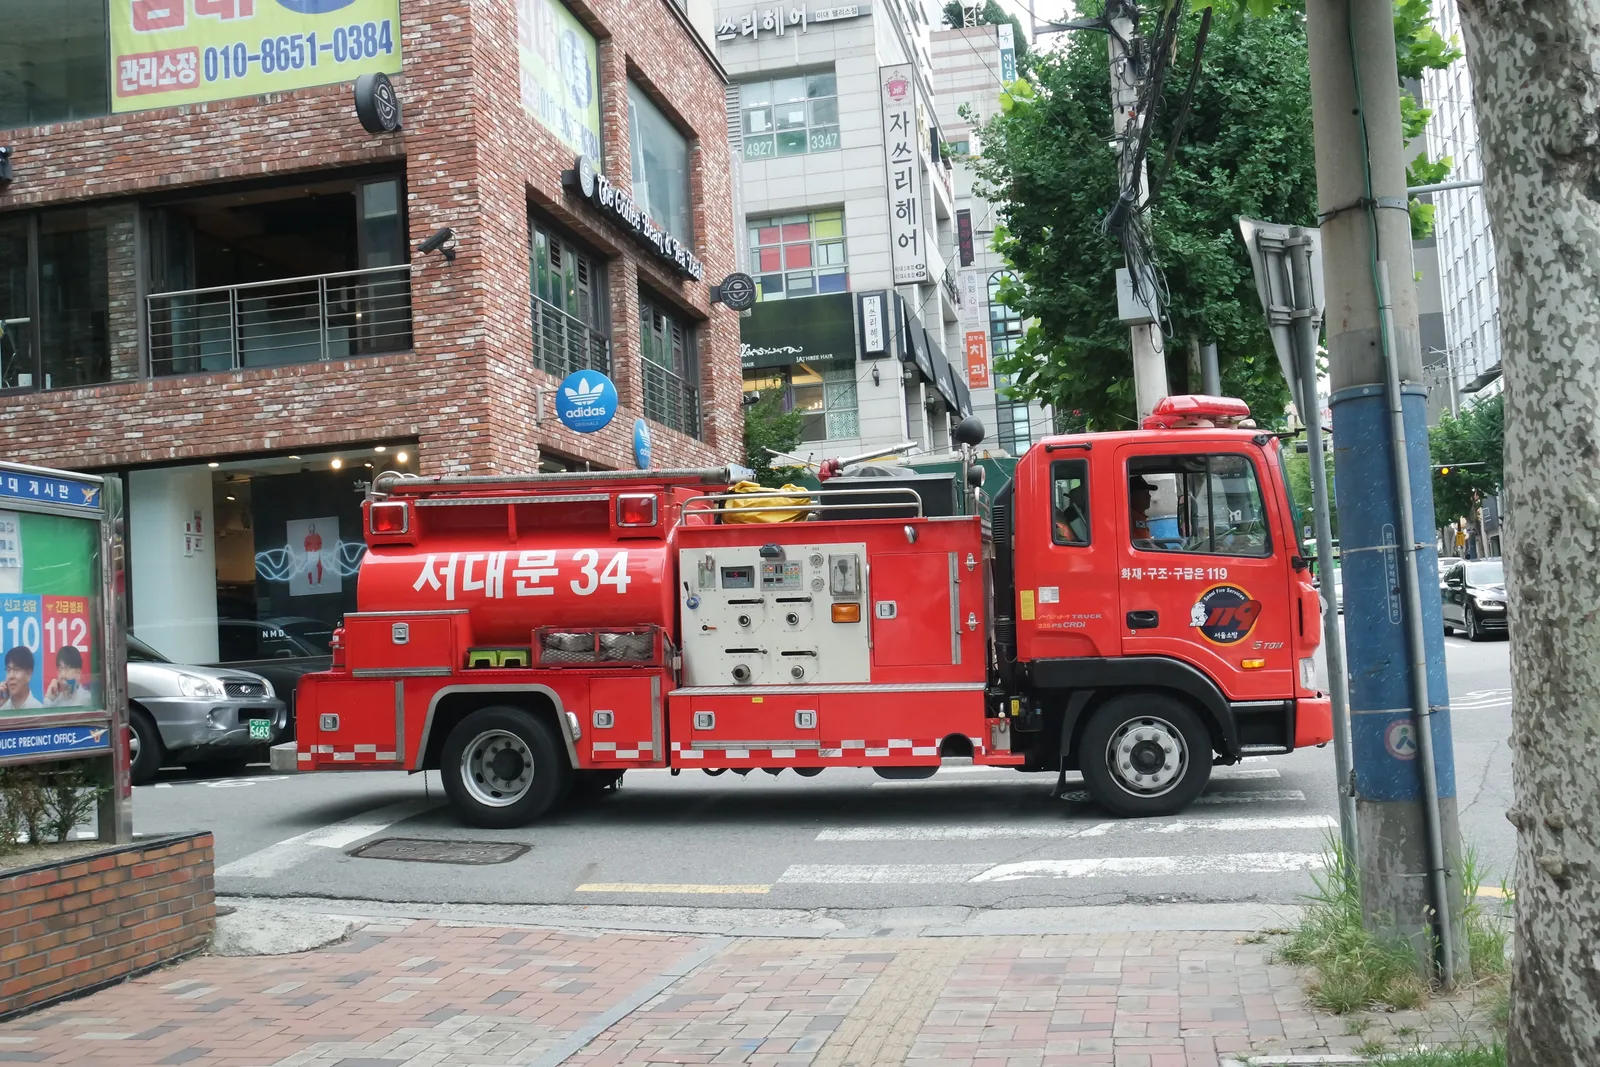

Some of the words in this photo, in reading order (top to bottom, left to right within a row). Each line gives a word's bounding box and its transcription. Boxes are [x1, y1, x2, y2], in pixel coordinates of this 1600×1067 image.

[717, 2, 807, 41] 쓰리헤어
[120, 52, 197, 93] 관리소장
[204, 19, 393, 83] 010-8651-0384
[746, 141, 772, 156] 4927
[811, 133, 837, 149] 3347
[889, 110, 917, 256] 자쓰리헤어
[597, 173, 613, 207] The
[615, 189, 641, 229] Coffee
[641, 211, 664, 254] Bean
[665, 231, 672, 255] &
[672, 238, 686, 268] Tea
[686, 250, 703, 280] Leaf
[868, 298, 879, 349] 자쓰리헤어
[970, 344, 986, 378] 치과
[565, 407, 606, 419] adidas
[0, 476, 18, 493] 대
[29, 480, 69, 499] 게시판
[413, 552, 559, 600] 서대문
[570, 549, 631, 596] 34
[1207, 567, 1228, 580] 119
[4, 599, 21, 612] 신고
[1205, 600, 1262, 631] 119
[45, 617, 88, 653] 112
[1214, 631, 1238, 639] 서울소방
[1252, 641, 1263, 650] 5
[19, 735, 51, 749] PRECINCT
[53, 732, 77, 744] OFFICE
